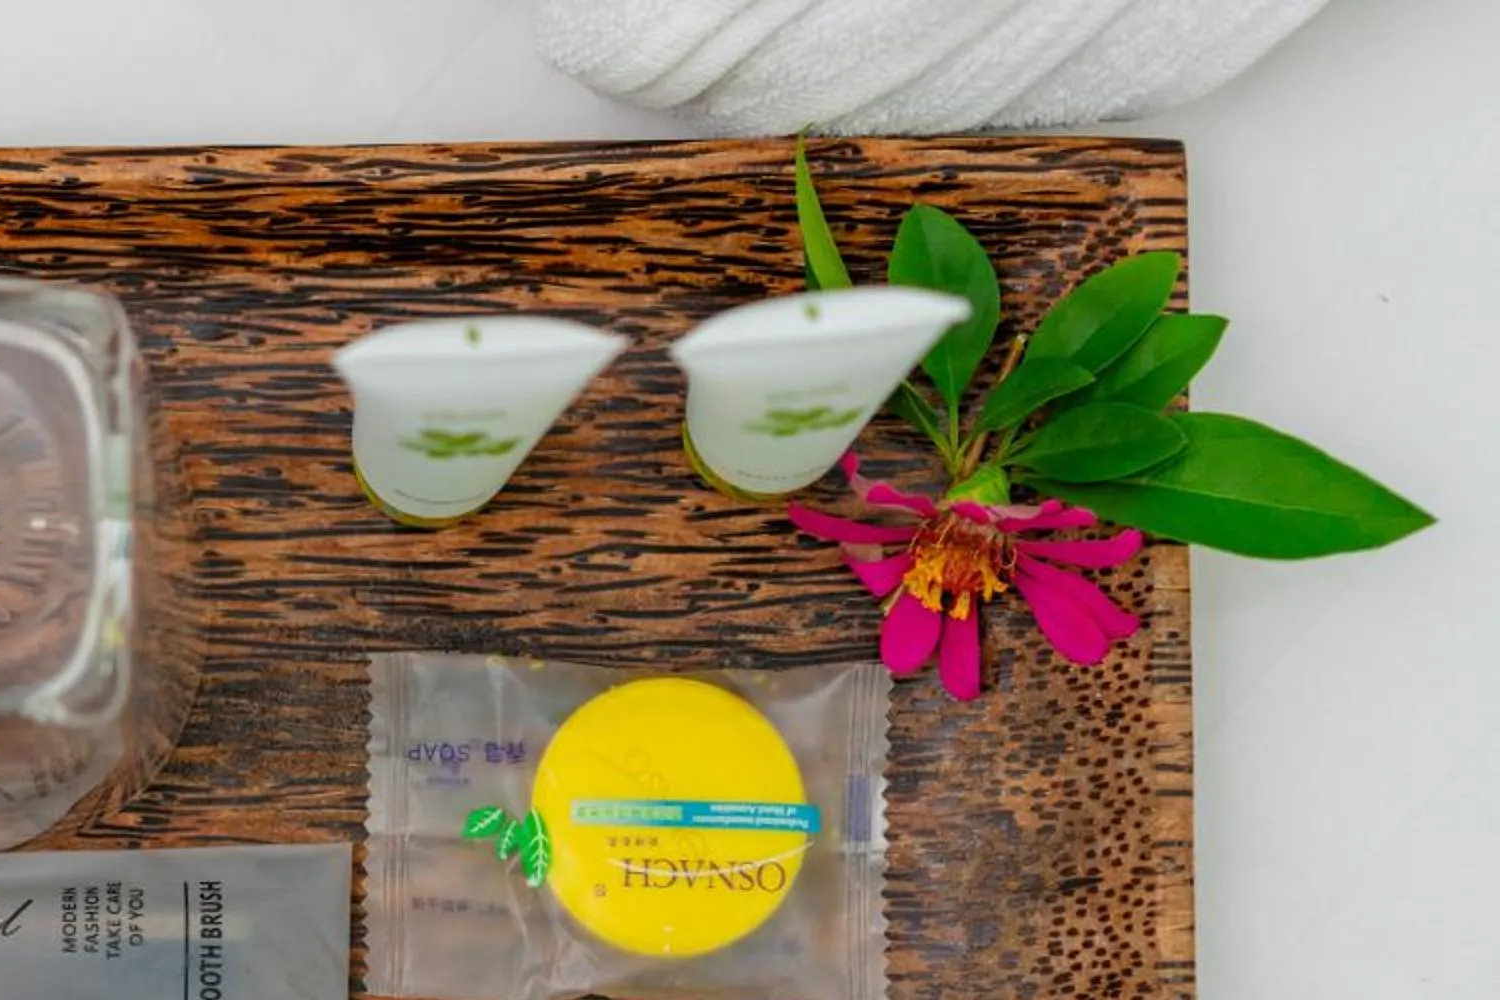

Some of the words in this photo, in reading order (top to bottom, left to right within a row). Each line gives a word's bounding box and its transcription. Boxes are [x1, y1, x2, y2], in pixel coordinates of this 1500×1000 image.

[408, 742, 472, 764] SOAP
[621, 857, 788, 895] OSNACH
[105, 880, 123, 915] CARE
[128, 888, 145, 922] YOU
[198, 880, 224, 940] BRUSH
[61, 886, 78, 954] MODERN
[83, 886, 100, 954] FASHION
[128, 924, 144, 948] OF
[105, 920, 122, 960] TAKE
